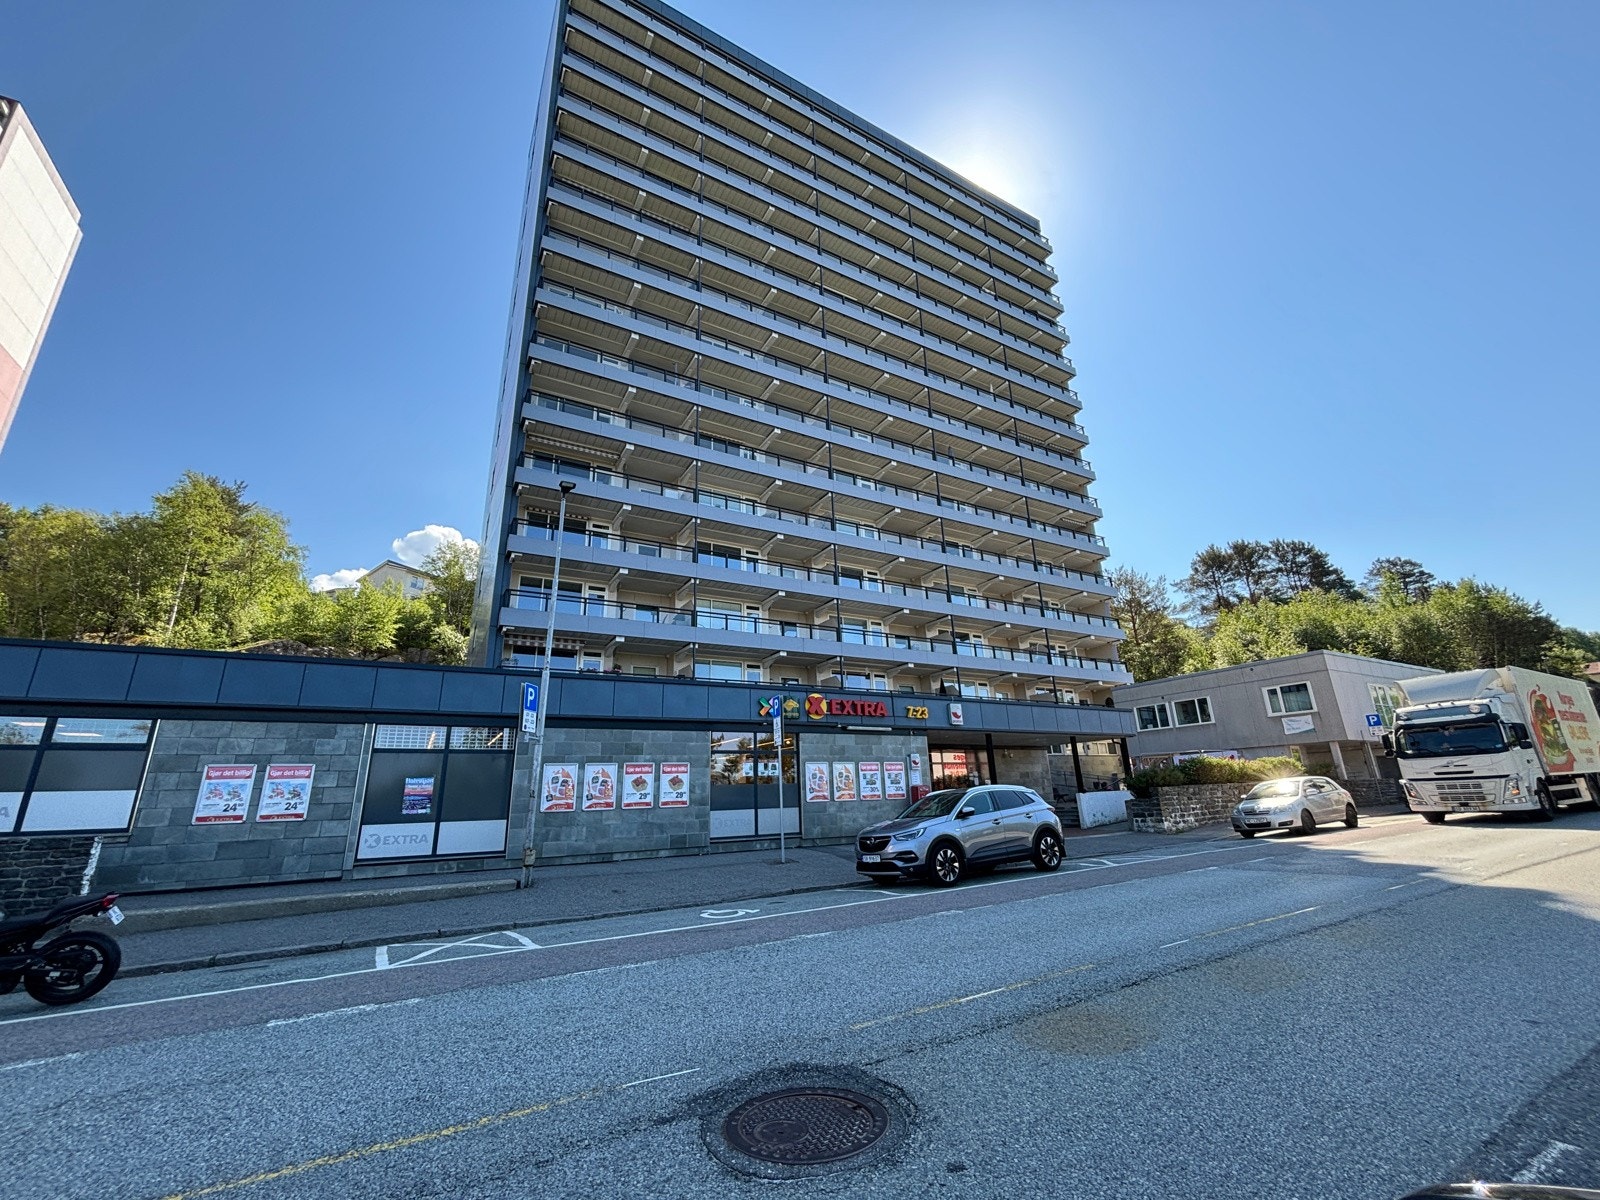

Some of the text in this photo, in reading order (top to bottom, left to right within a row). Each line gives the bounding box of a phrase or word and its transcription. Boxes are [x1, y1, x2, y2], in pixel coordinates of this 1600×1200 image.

[527, 687, 535, 707] P
[774, 699, 779, 715] P
[830, 699, 888, 717] EXTRA
[1369, 715, 1378, 725] P
[382, 834, 429, 846] EXTRA
